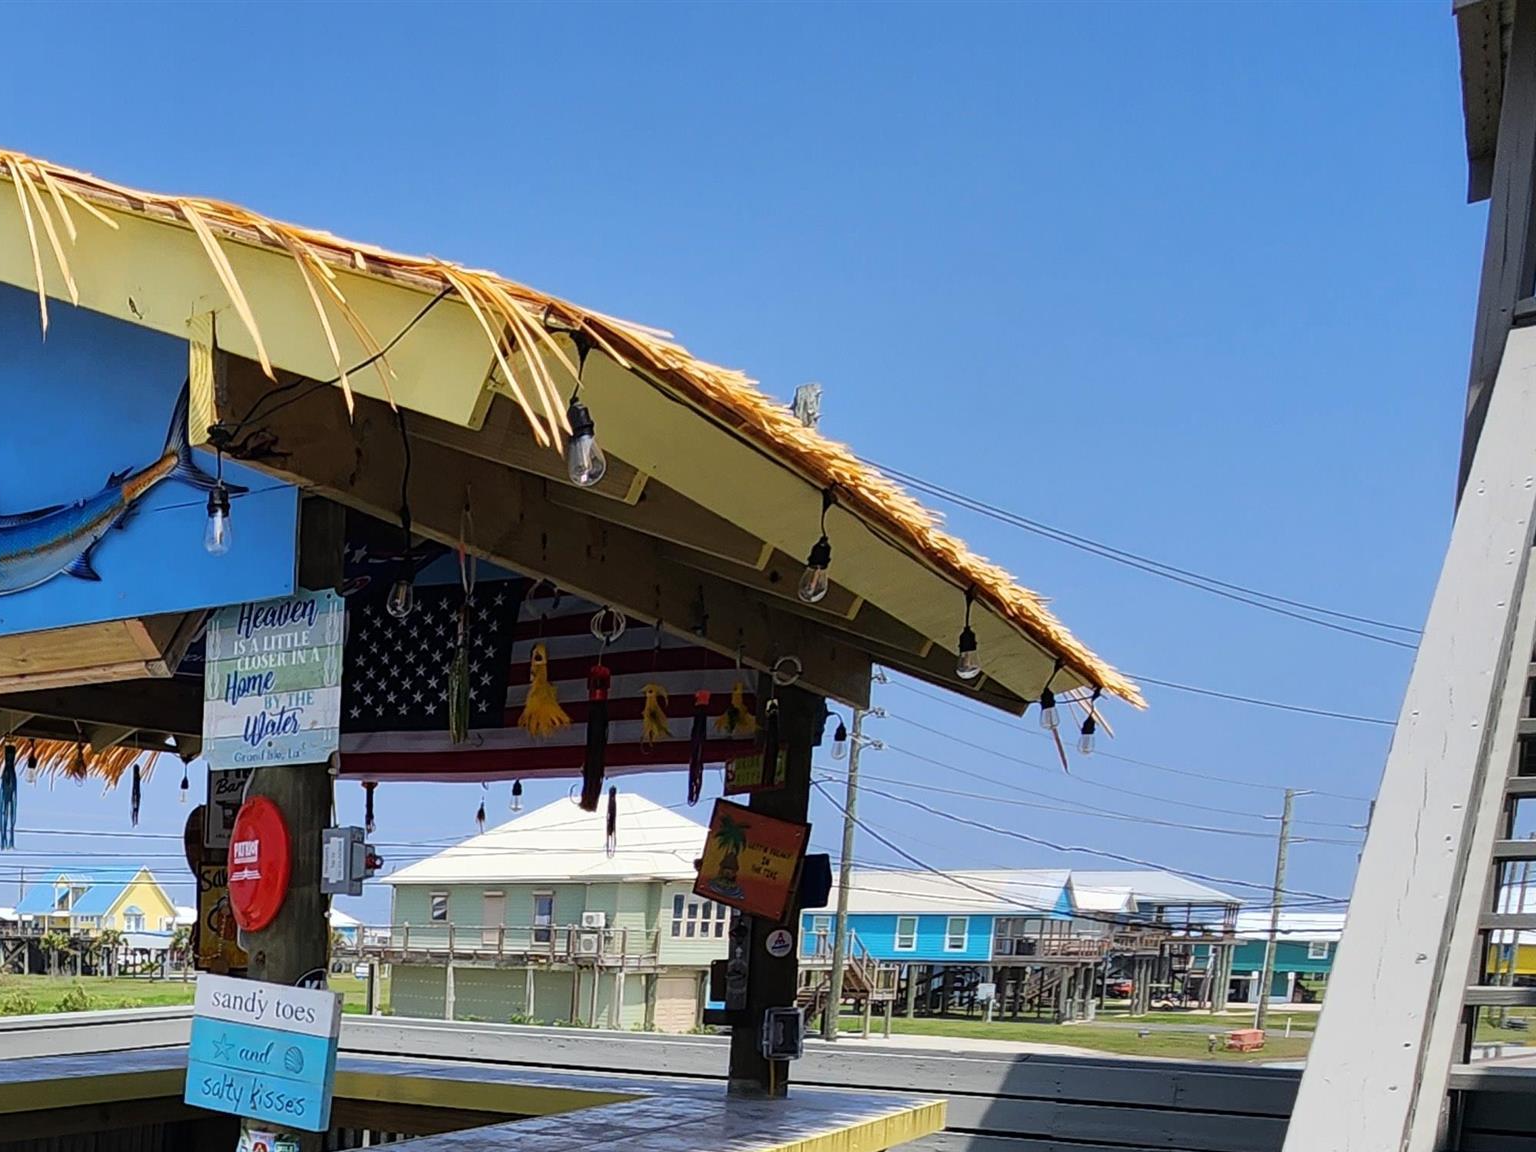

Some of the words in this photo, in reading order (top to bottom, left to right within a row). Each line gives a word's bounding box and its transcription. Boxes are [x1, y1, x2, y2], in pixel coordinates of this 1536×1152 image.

[237, 599, 319, 638] Heaven
[234, 640, 246, 655] IS
[247, 639, 258, 652] A
[264, 631, 310, 651] LITTLE
[237, 653, 287, 671] CLOSER
[292, 650, 306, 665] IN
[310, 648, 320, 662] A
[225, 670, 275, 705] Home
[264, 695, 282, 709] BY
[288, 692, 313, 707] THE
[243, 706, 304, 747] Water
[212, 989, 268, 1020] sandy
[275, 1000, 315, 1023] toes
[239, 1042, 274, 1065] and
[201, 1073, 244, 1112] salty
[250, 1077, 305, 1116] kisses
